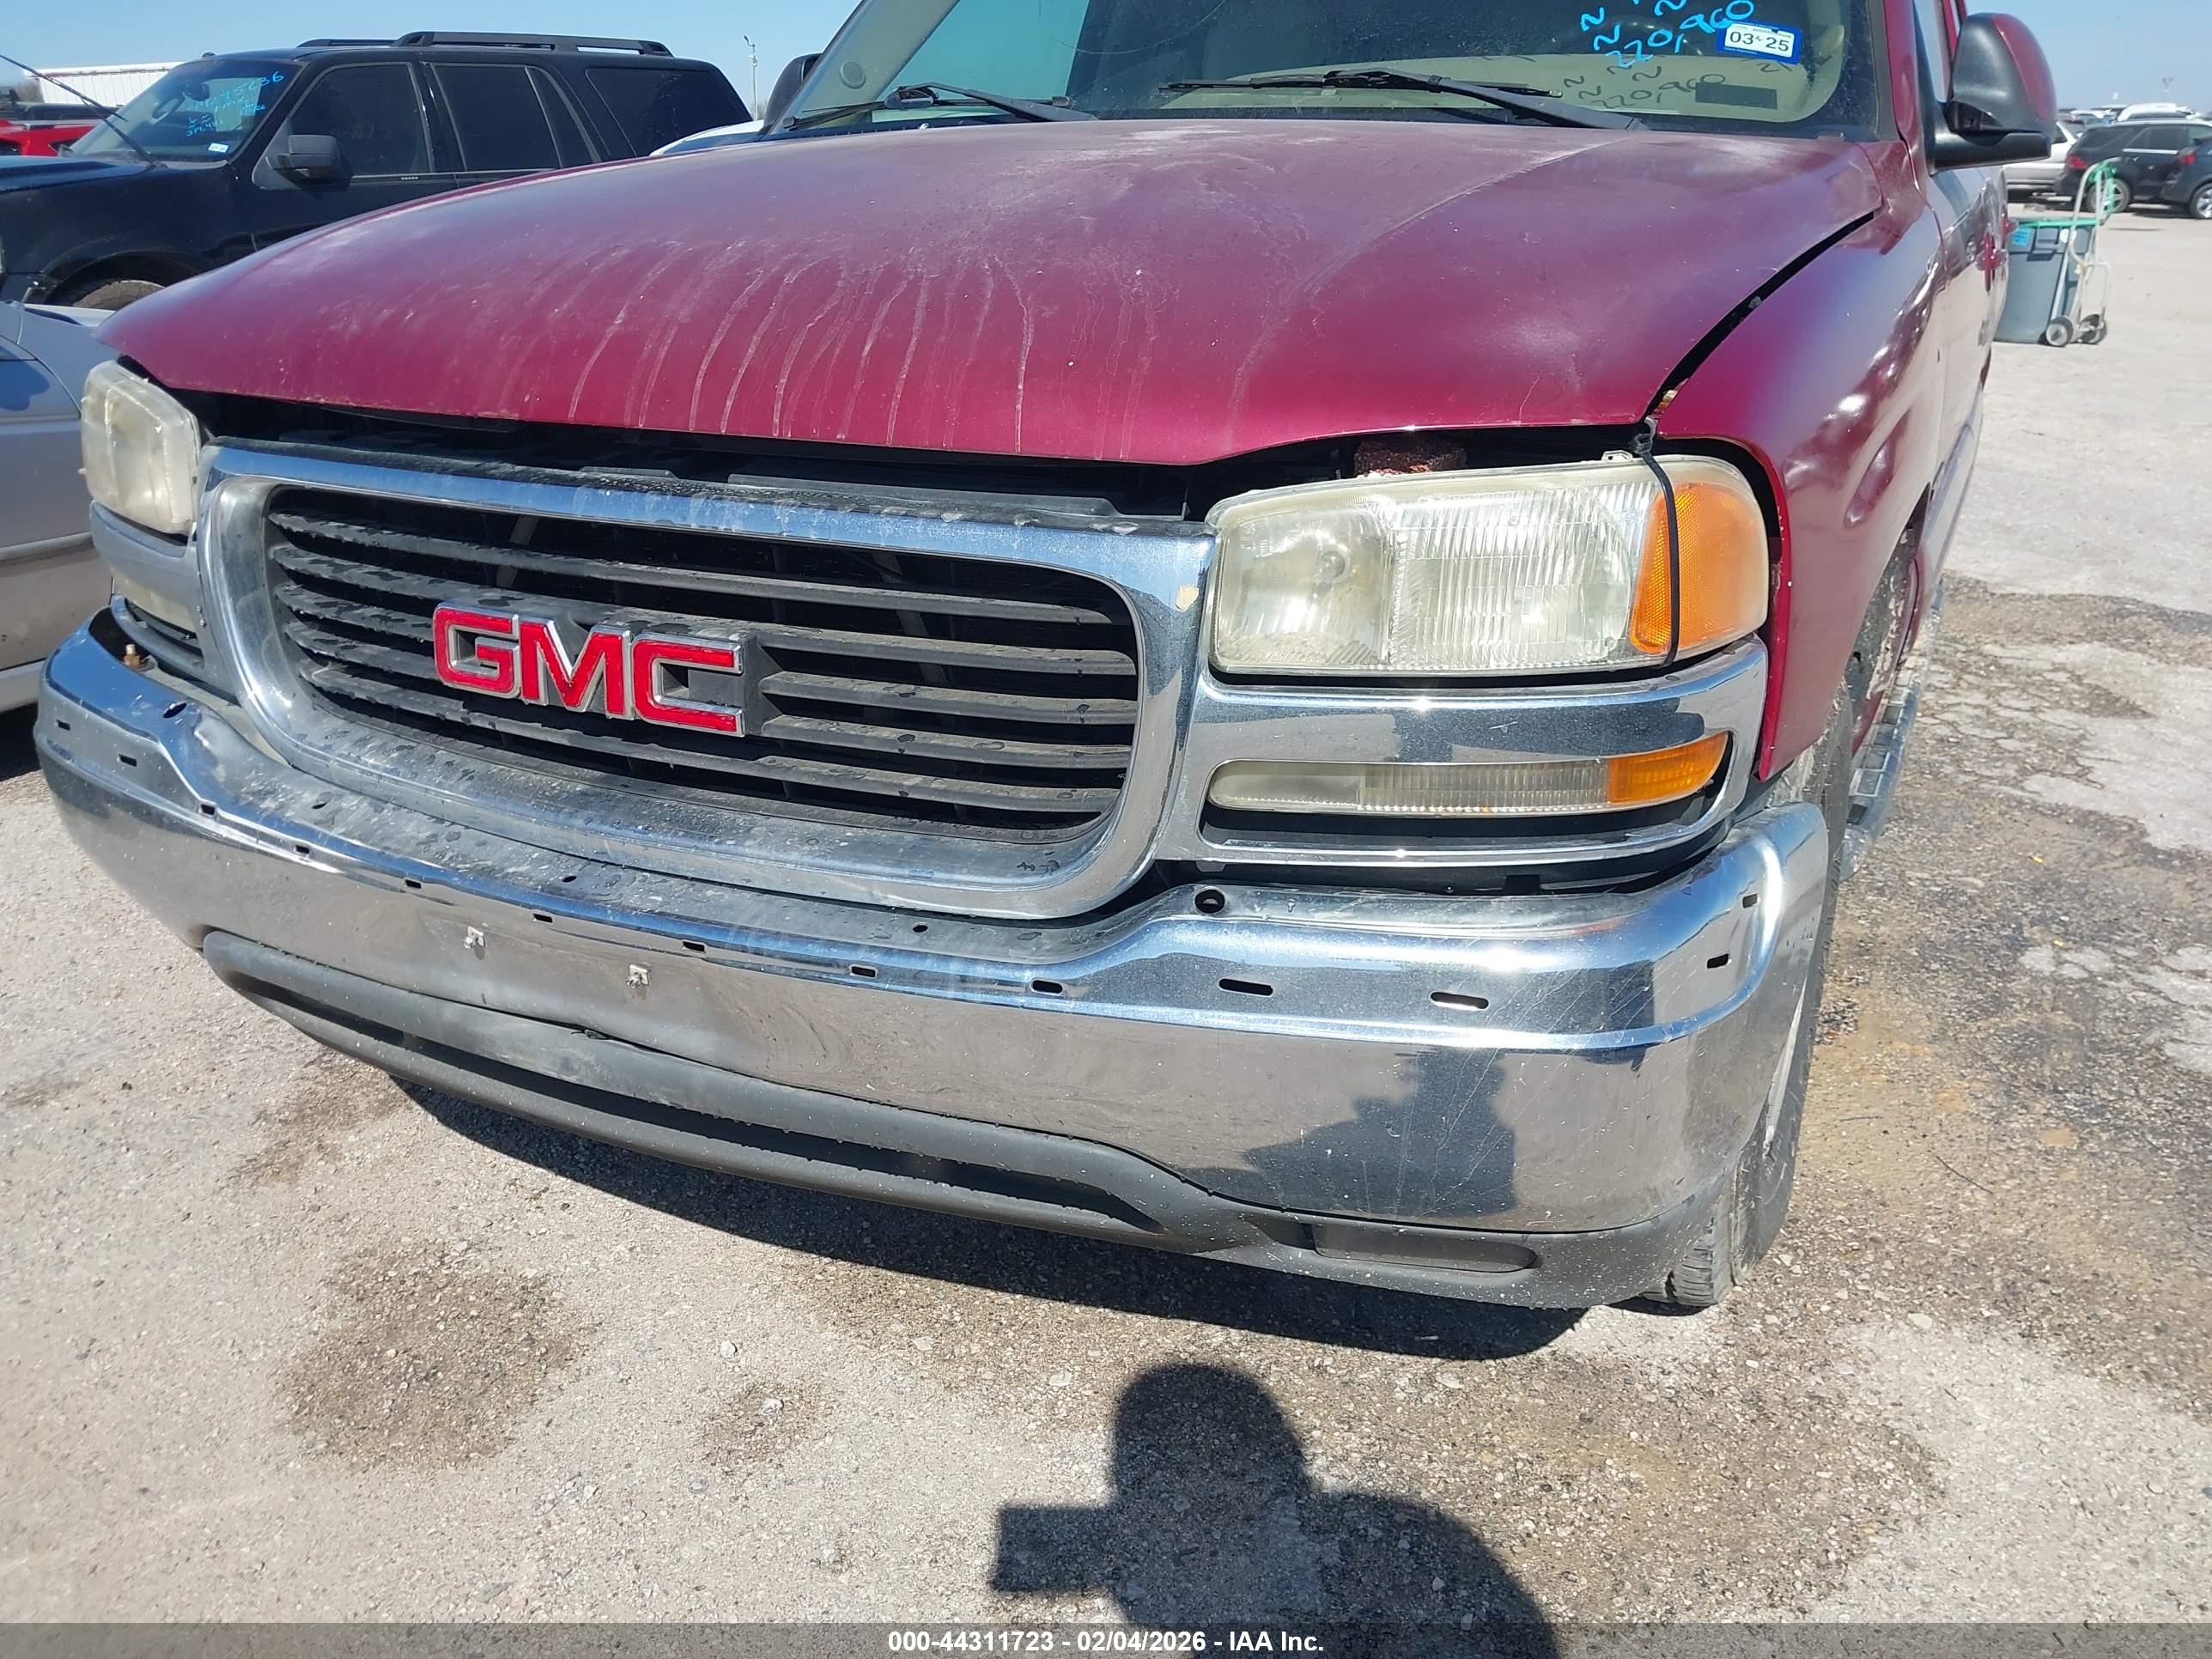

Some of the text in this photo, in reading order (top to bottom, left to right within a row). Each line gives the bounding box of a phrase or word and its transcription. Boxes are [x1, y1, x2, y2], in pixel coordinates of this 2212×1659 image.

[1729, 31, 1754, 45] 03
[1765, 36, 1790, 52] 25
[433, 601, 744, 737] GMC
